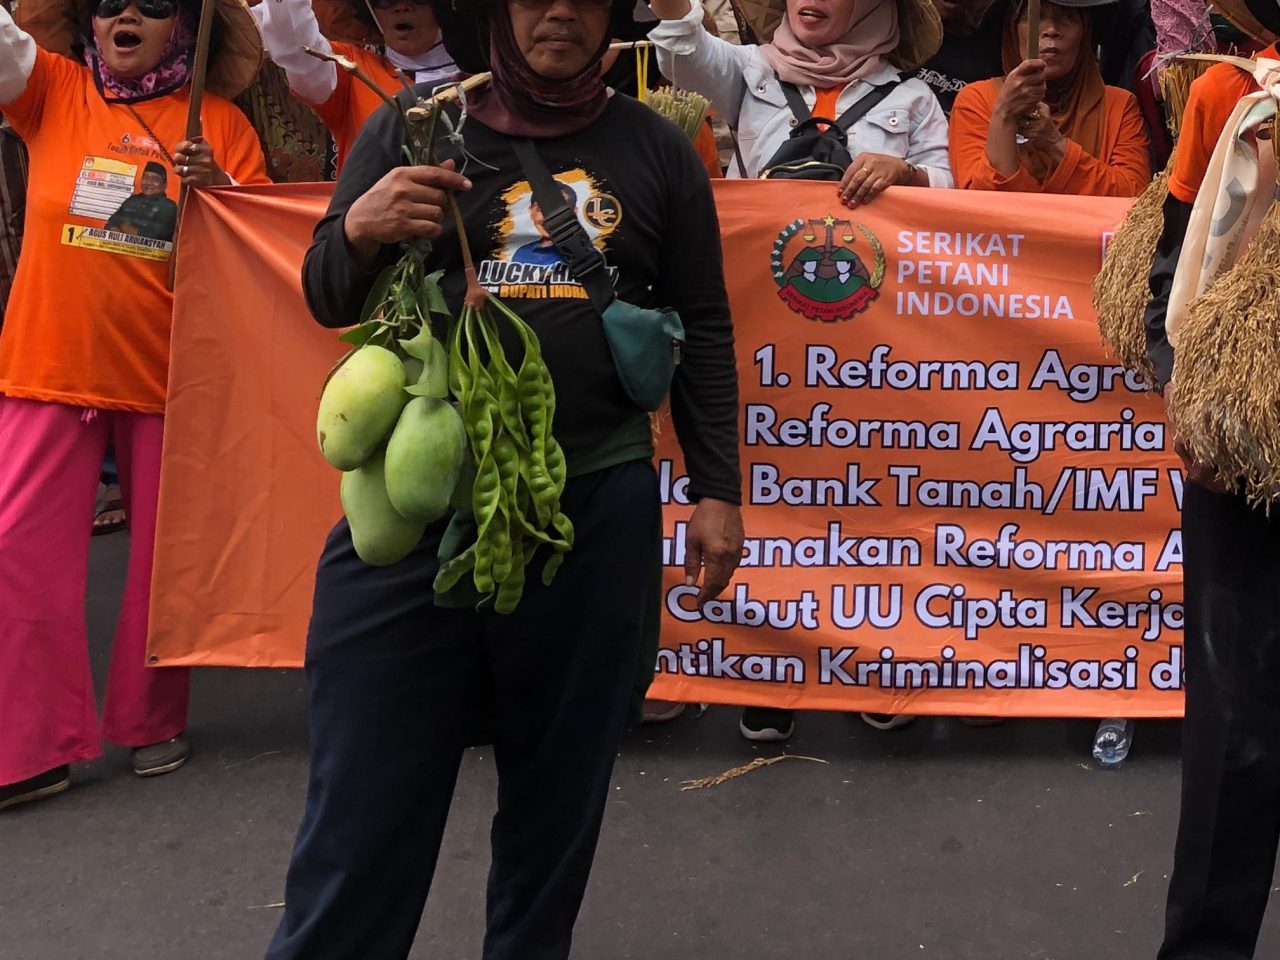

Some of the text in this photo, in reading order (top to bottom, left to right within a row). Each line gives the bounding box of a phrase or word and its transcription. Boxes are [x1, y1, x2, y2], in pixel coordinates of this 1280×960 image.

[68, 227, 75, 243] 1
[896, 230, 1025, 257] SERIKAT
[480, 260, 551, 284] LUCKY
[896, 261, 1009, 286] PETANI
[500, 285, 590, 299] BUPATI INDRA
[896, 291, 1074, 319] INDONESIA
[754, 345, 790, 387] 1.
[806, 345, 1018, 390] Reforma
[746, 403, 959, 450] Reforma
[969, 407, 1165, 462] Agraria
[751, 463, 881, 507] Bank
[888, 465, 1159, 515] Tanah/IMF
[935, 523, 1144, 571] Reforma
[666, 583, 819, 629] Cabut
[831, 584, 902, 628] UU
[914, 583, 1048, 640] Cipta
[655, 638, 804, 683] ntikan
[818, 642, 1138, 690] Kriminalisasi
